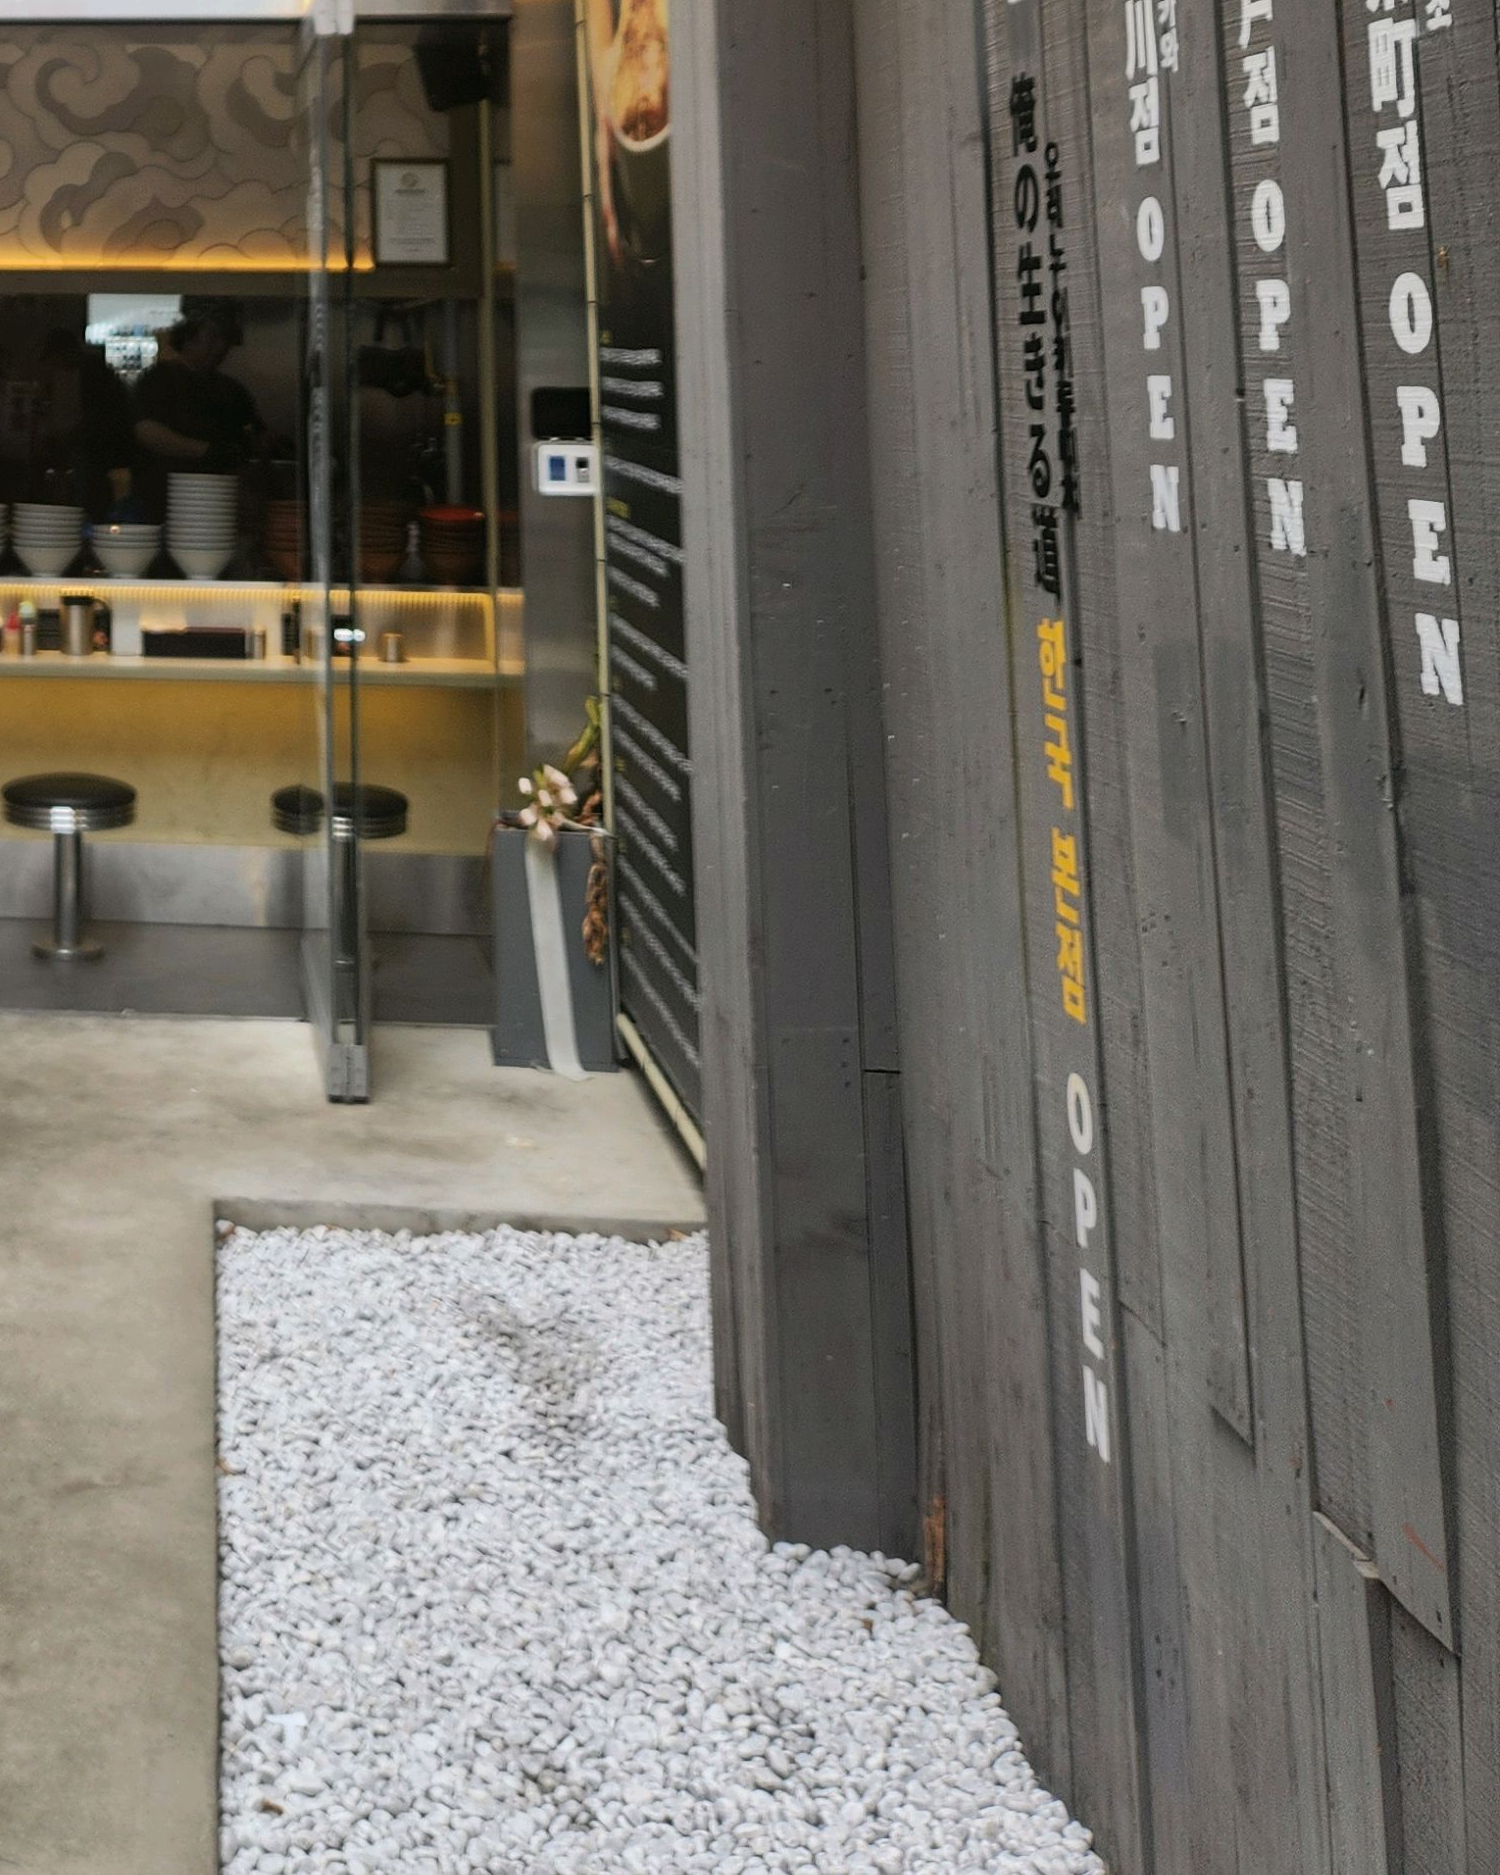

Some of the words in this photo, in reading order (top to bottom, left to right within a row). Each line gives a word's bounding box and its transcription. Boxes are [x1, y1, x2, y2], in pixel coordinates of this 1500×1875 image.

[1136, 196, 1181, 532] OPEN
[1252, 179, 1307, 557] OPEN
[1389, 272, 1464, 706] OPEN
[1051, 827, 1088, 1024] 본점
[1066, 1072, 1111, 1463] OPEN
